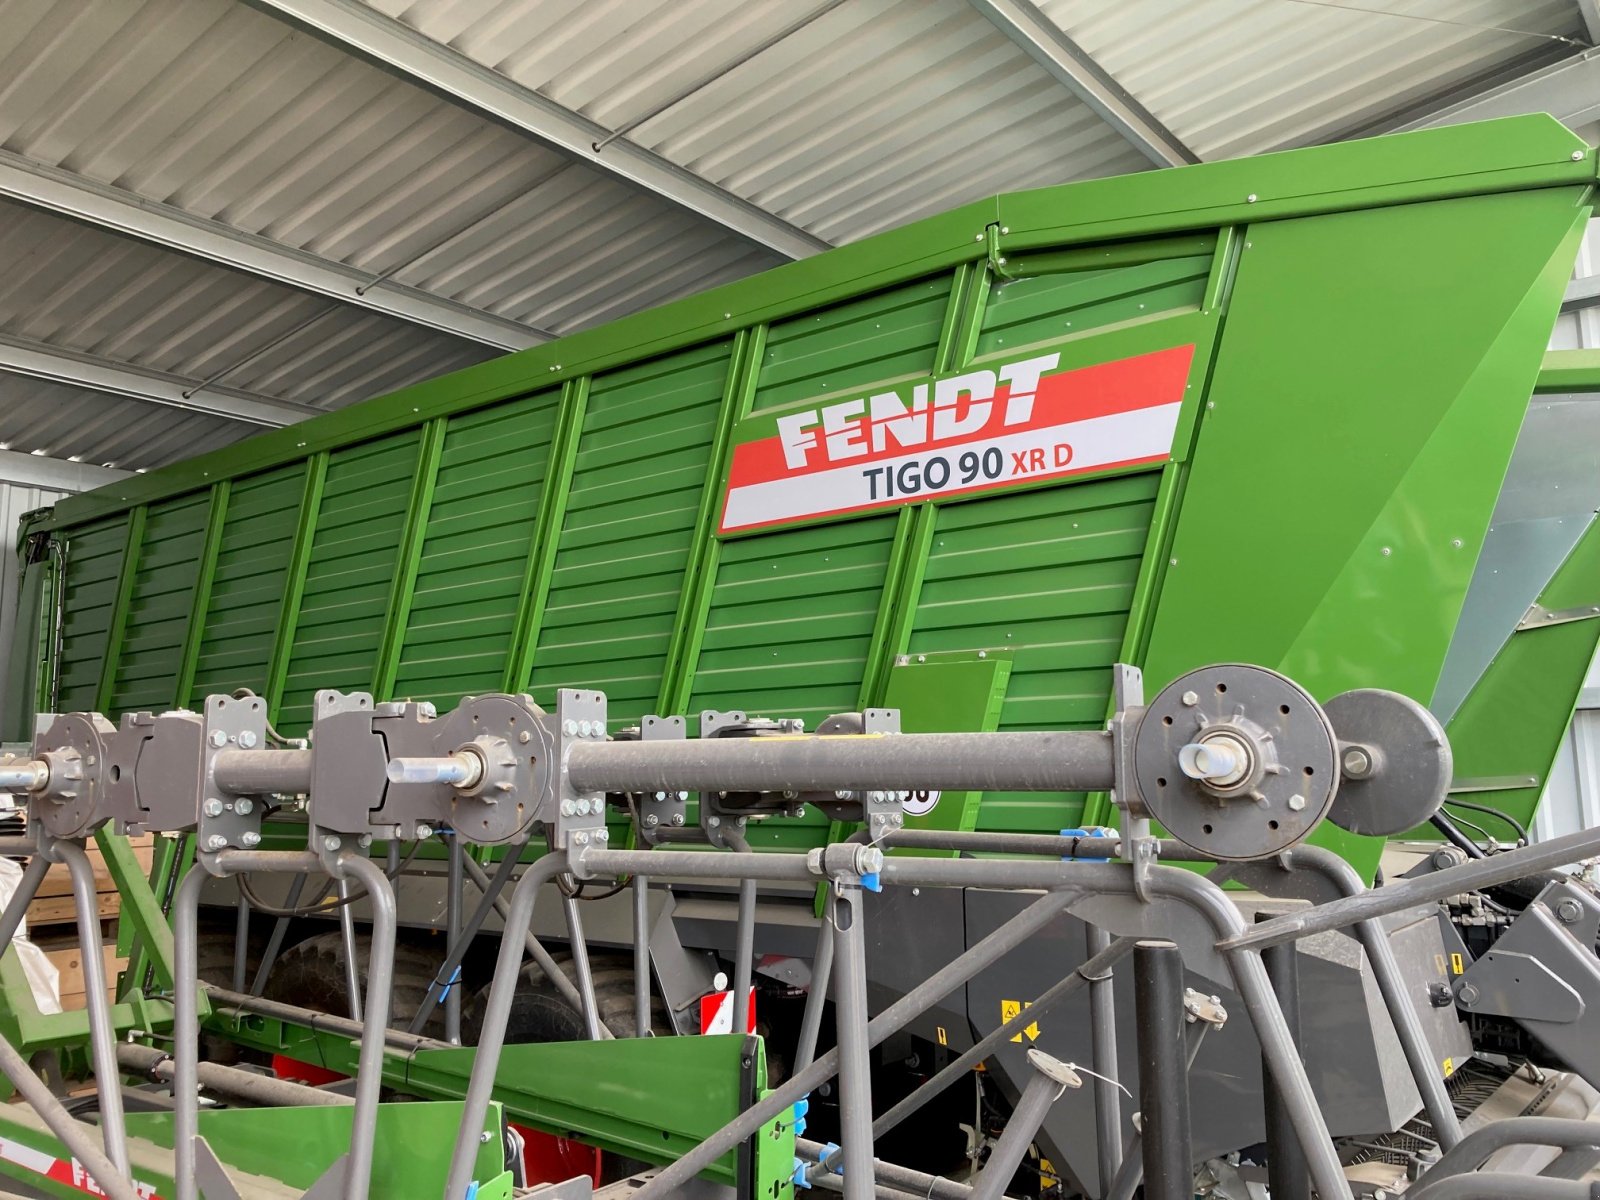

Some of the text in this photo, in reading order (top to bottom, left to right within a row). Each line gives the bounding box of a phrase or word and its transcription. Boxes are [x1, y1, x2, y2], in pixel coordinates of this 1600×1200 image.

[776, 351, 1061, 471] FENDT
[863, 443, 1074, 501] TIGO 90 XR D
